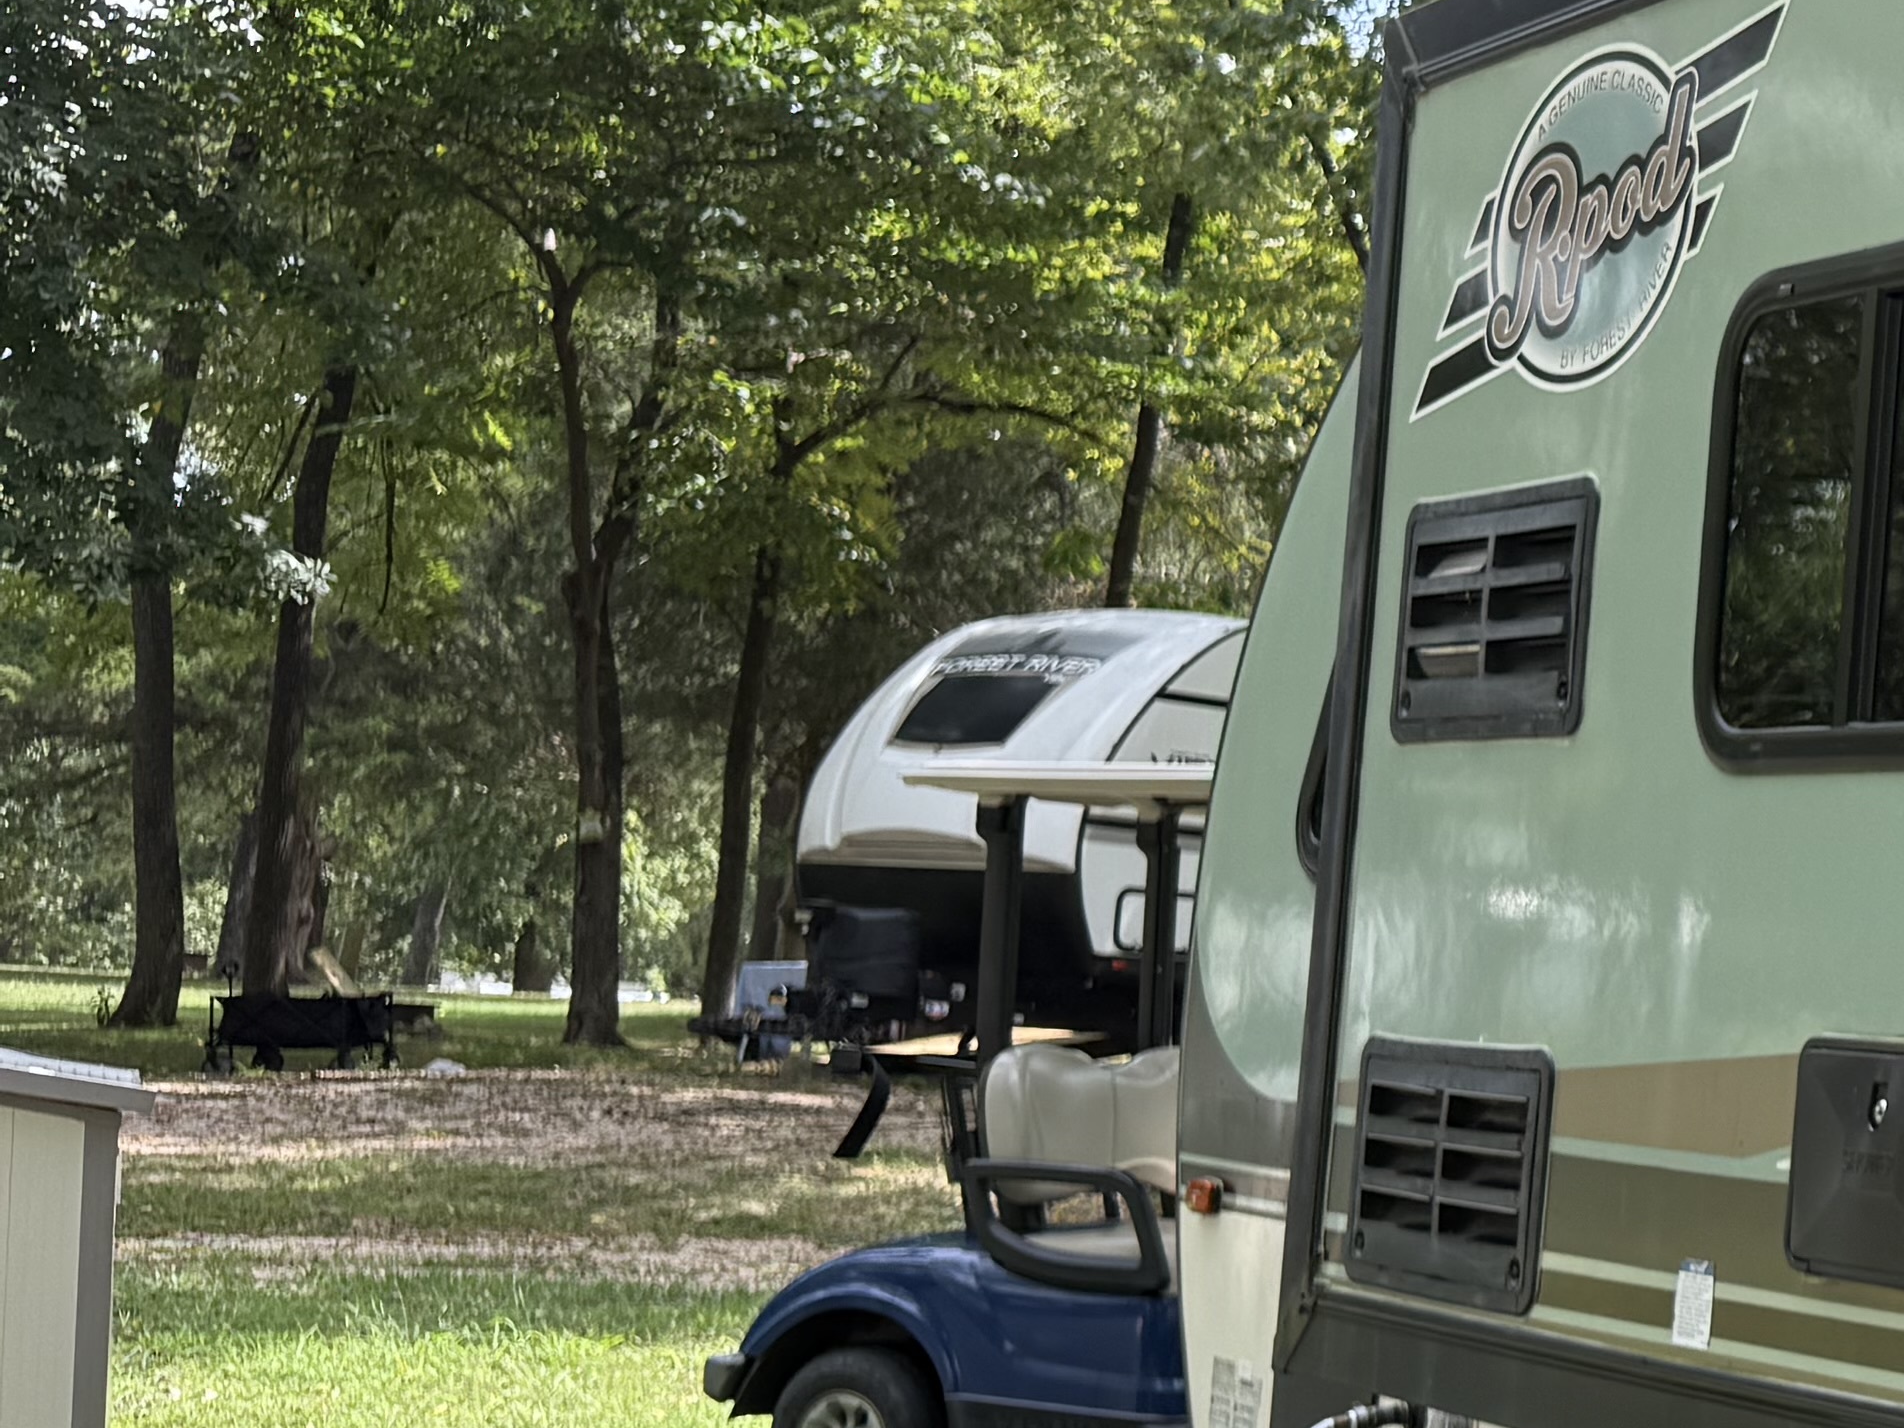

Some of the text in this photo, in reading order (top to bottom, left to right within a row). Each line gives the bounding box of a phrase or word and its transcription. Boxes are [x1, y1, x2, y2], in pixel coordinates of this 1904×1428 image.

[1549, 71, 1608, 126] GENUINE
[1611, 70, 1663, 113] CLASSIC
[1560, 348, 1577, 368] BY
[1638, 242, 1673, 312] RIVER
[1024, 654, 1101, 675] RIVER
